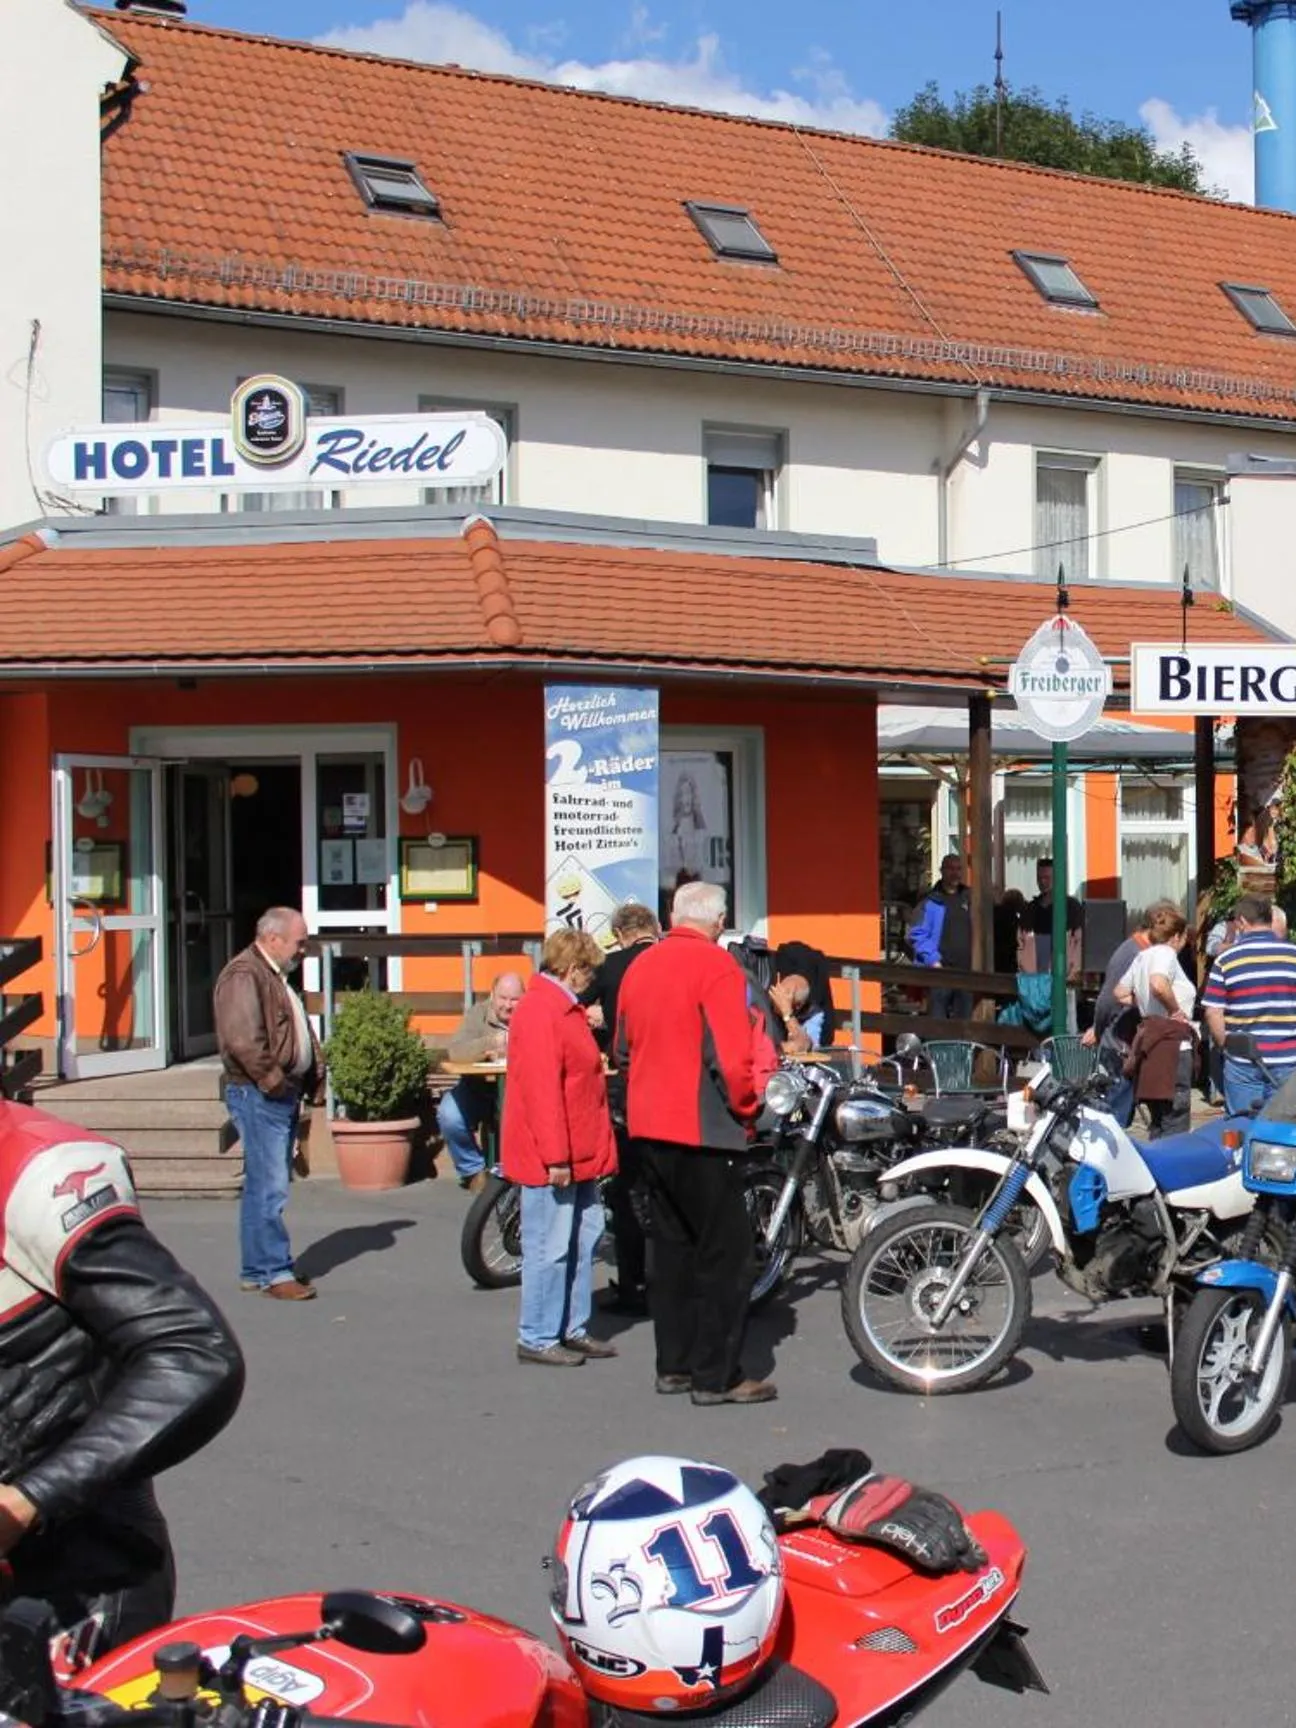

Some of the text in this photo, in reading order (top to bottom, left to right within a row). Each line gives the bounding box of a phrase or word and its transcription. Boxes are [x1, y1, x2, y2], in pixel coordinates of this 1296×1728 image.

[74, 429, 467, 480] HOTEL Riedel
[1019, 671, 1102, 696] Freiberger
[547, 691, 617, 720] Herzlich
[560, 708, 657, 731] Willkommen
[555, 840, 592, 852] Hotel
[641, 1508, 766, 1608] 11
